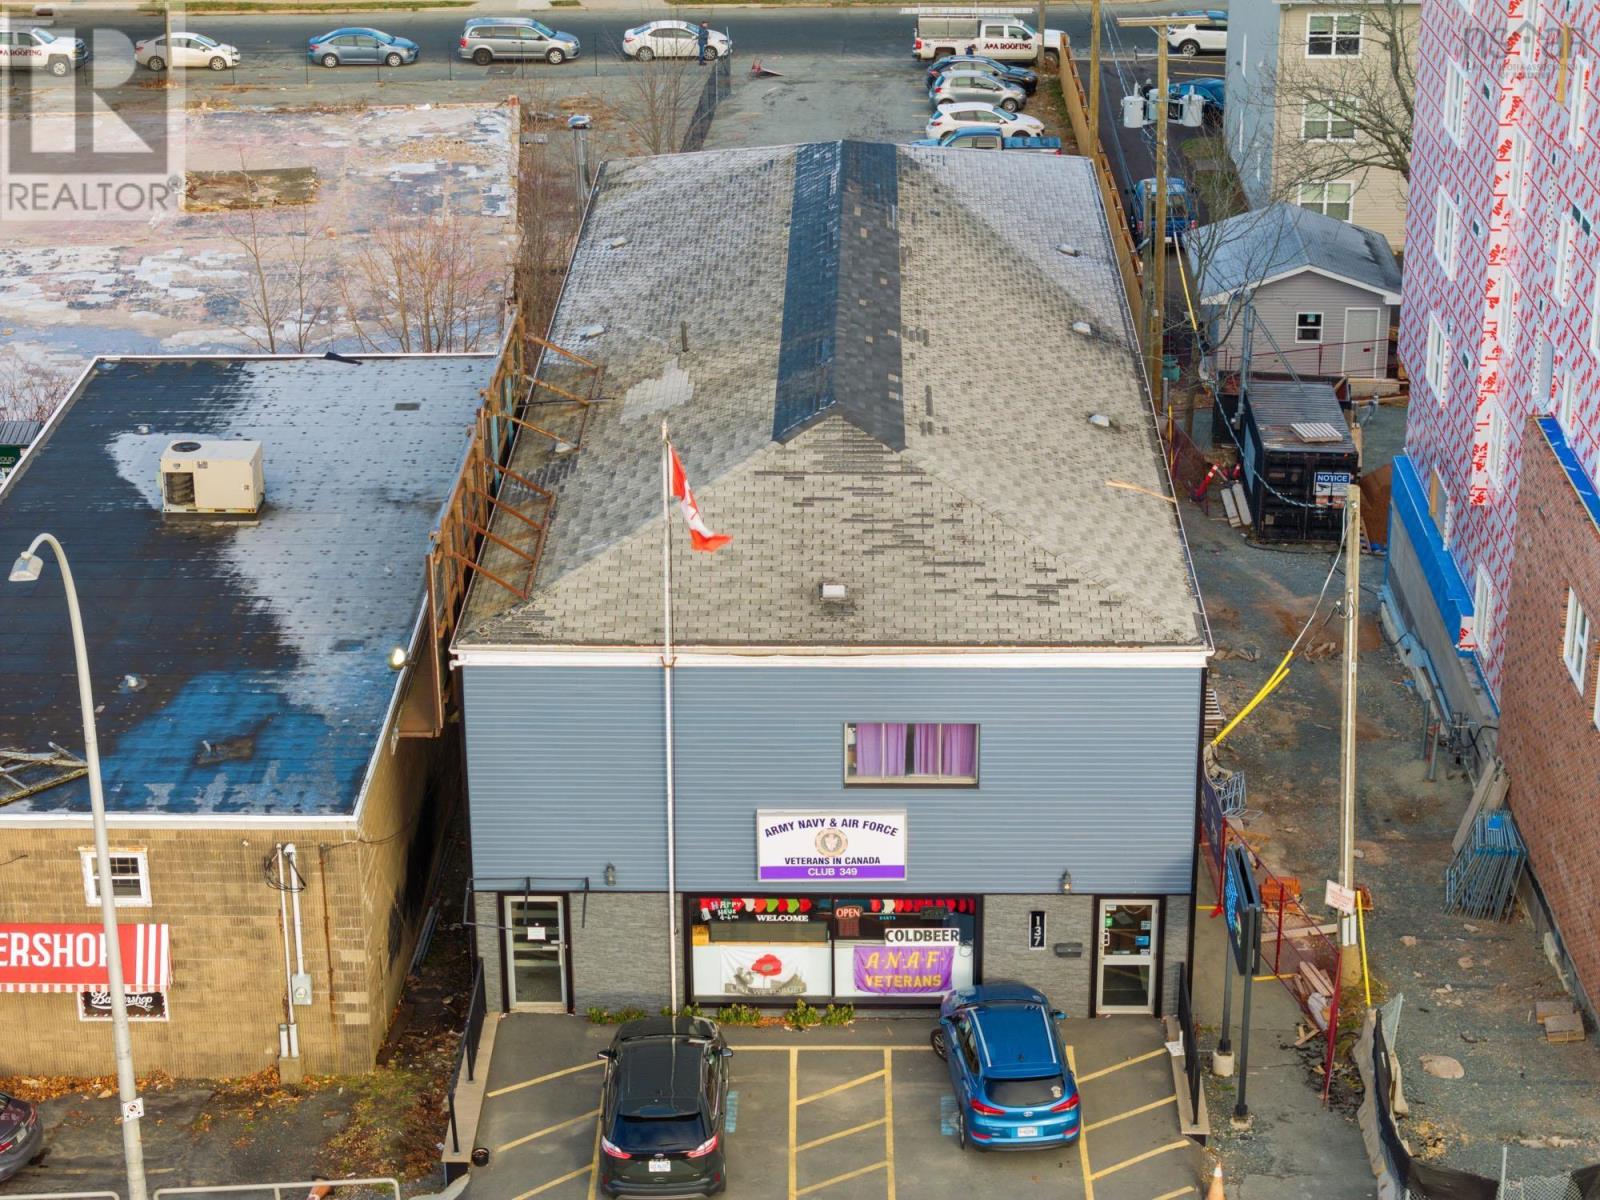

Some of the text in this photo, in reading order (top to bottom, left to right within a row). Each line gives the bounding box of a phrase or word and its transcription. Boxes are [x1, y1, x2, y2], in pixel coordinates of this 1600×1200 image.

[764, 818, 899, 838] ARMY NAVY & AIR FORCE
[785, 856, 881, 865] VETERANS IN CANADA
[807, 868, 858, 876] CLUB 349
[756, 914, 809, 922] WELCOME
[836, 907, 860, 918] OPEN
[1033, 915, 1042, 947] 137
[864, 974, 943, 988] VETERANS
